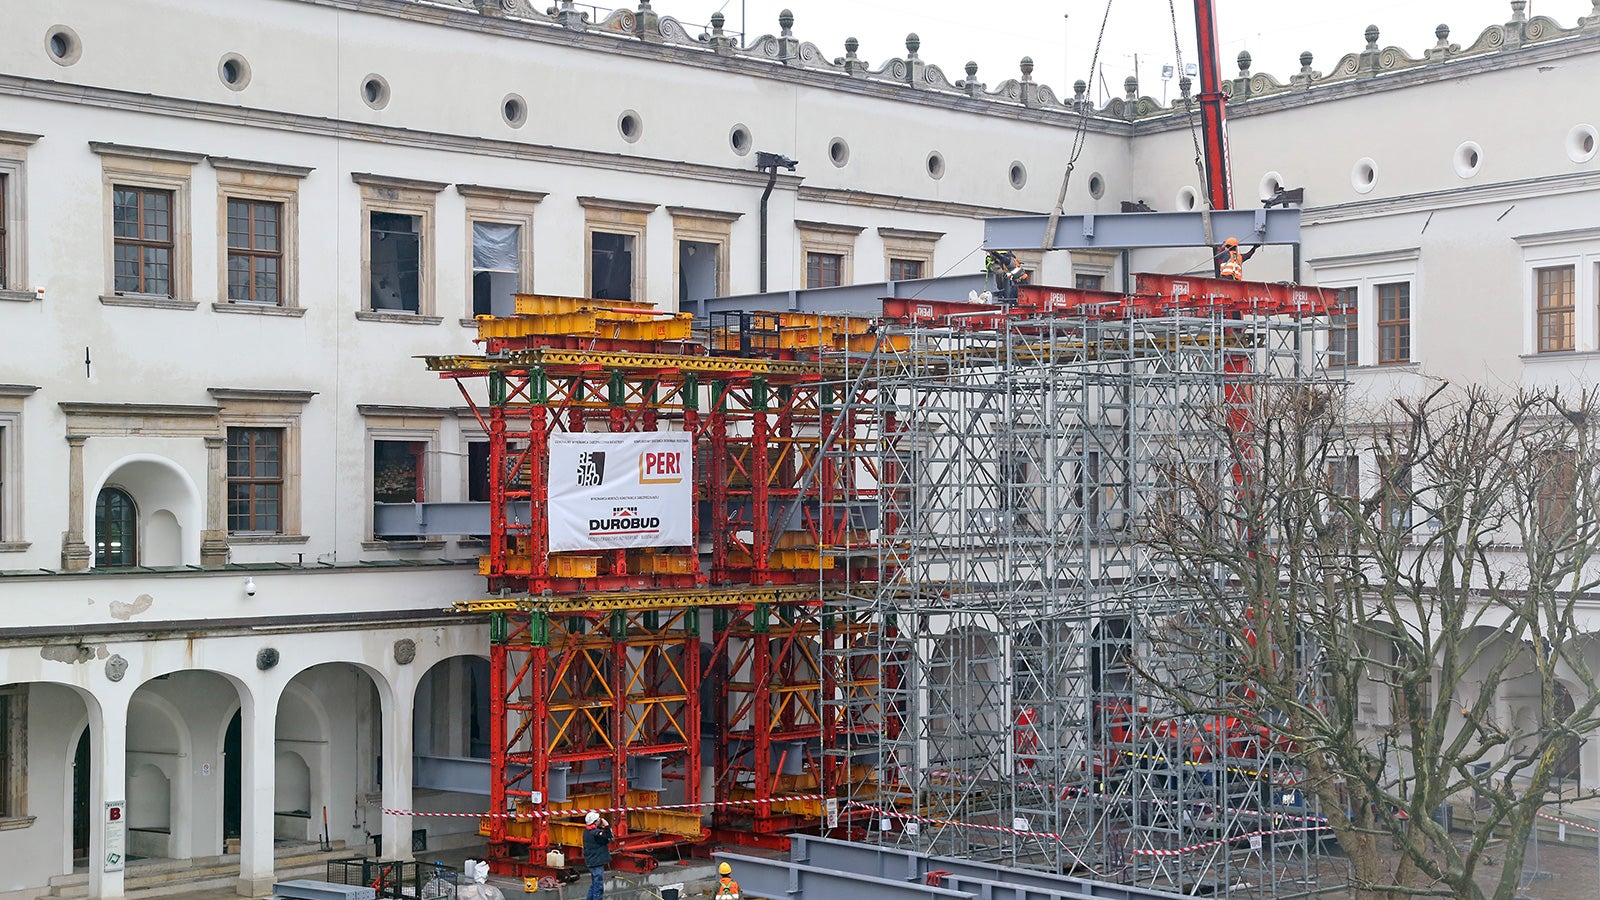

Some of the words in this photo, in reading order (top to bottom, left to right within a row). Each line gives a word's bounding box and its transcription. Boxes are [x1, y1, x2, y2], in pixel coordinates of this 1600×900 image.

[1052, 292, 1066, 303] PERI
[917, 307, 931, 317] PERI
[579, 452, 593, 463] RE
[645, 452, 681, 475] PERI
[576, 463, 596, 475] STA
[576, 474, 600, 486] URO
[589, 517, 660, 531] DUROBUD
[110, 807, 121, 821] B
